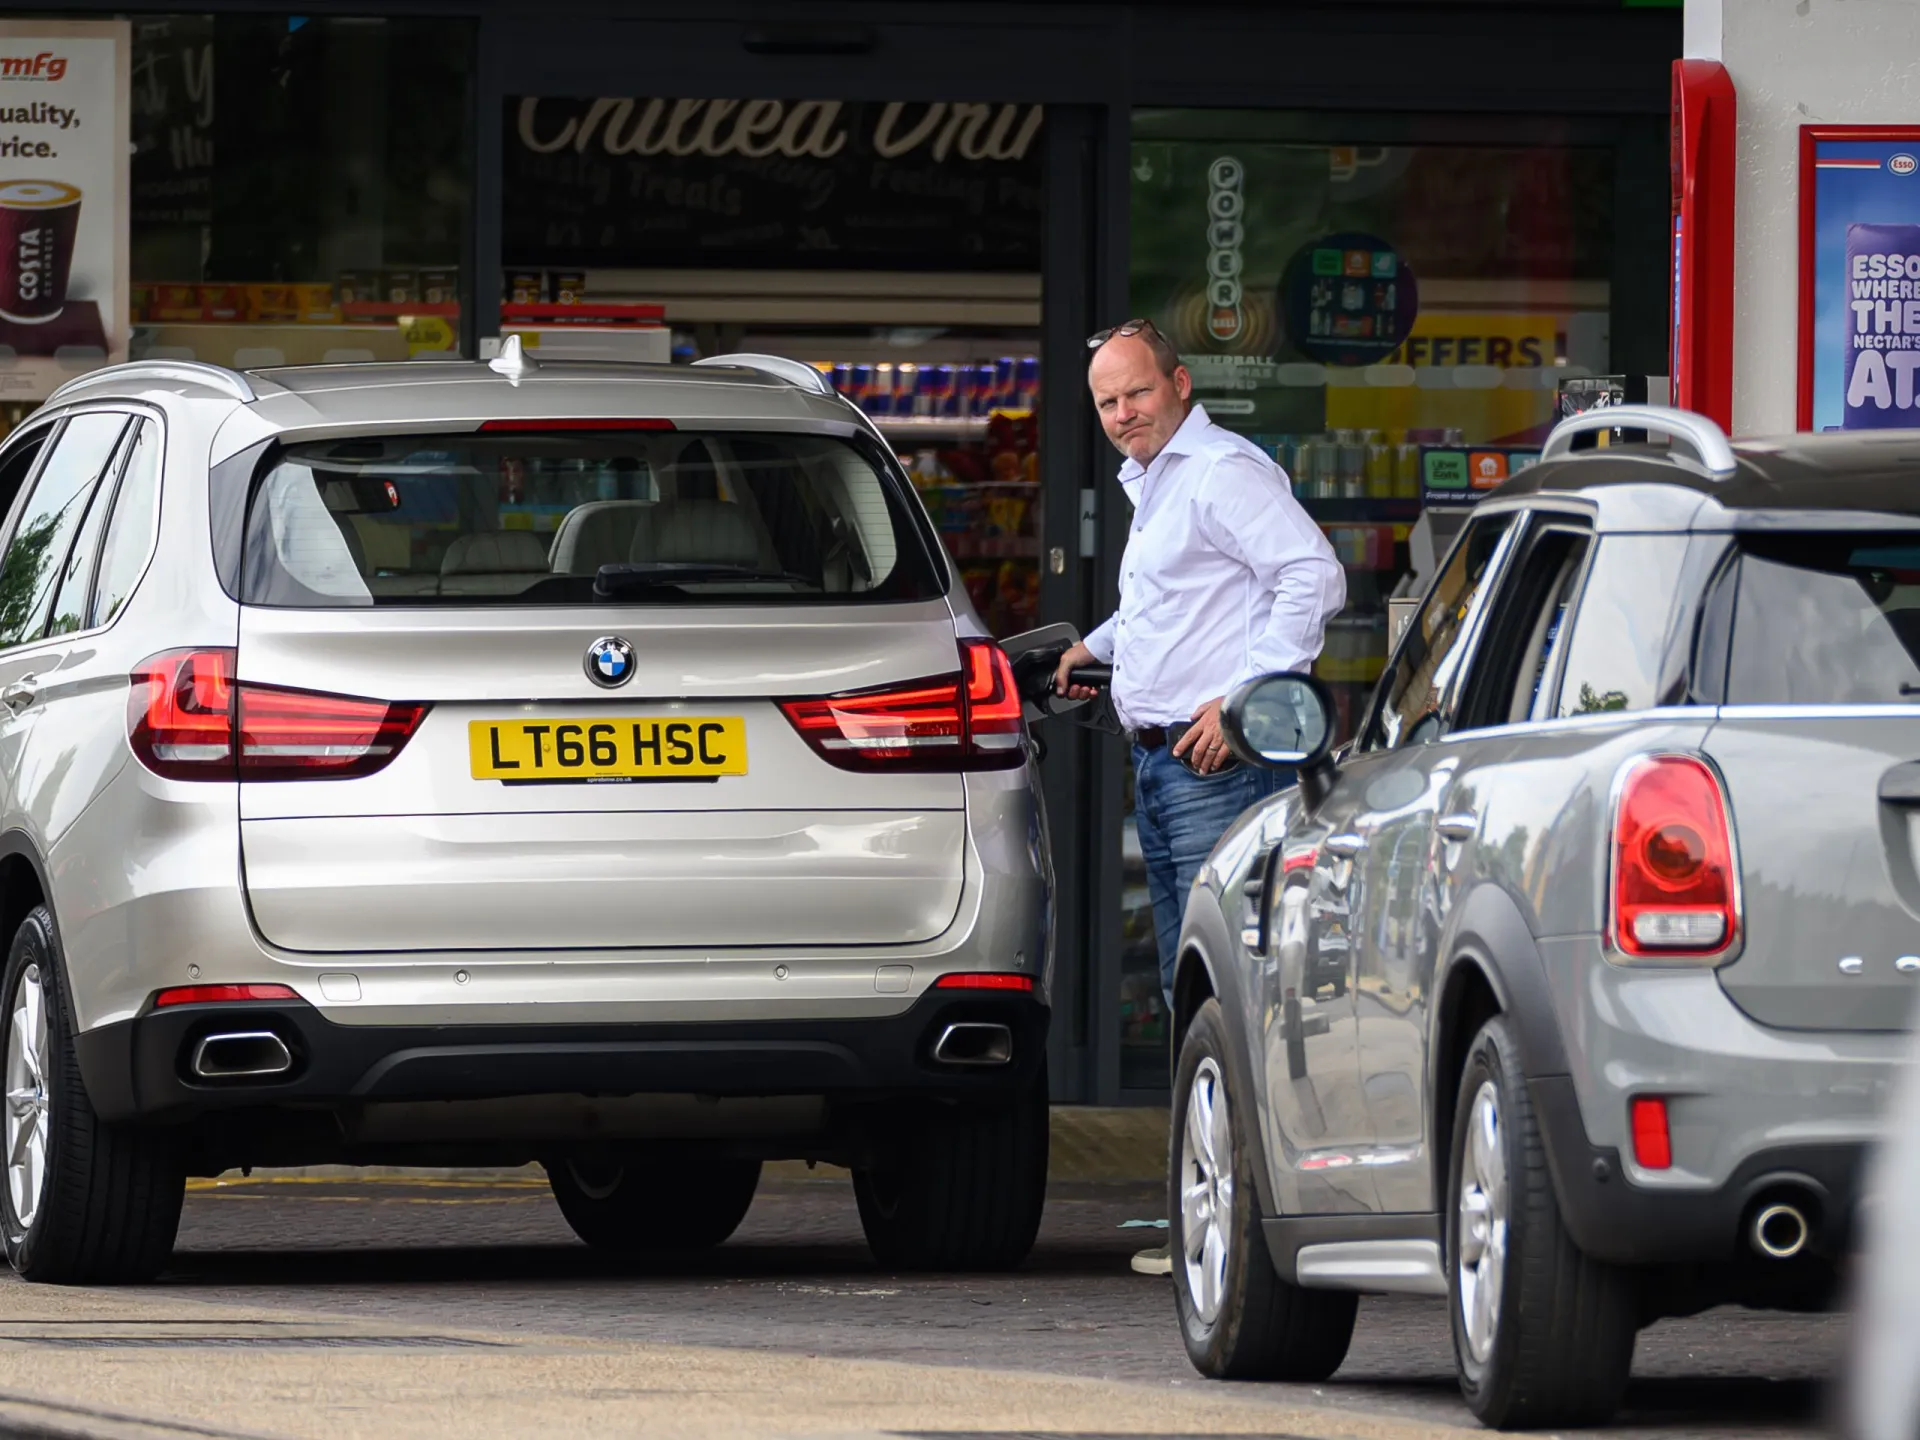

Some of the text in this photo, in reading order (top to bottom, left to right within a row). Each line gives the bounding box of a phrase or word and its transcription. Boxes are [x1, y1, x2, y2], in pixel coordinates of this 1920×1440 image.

[0, 52, 68, 82] mfg
[0, 102, 80, 129] uality,
[0, 135, 58, 158] rice.
[1893, 159, 1913, 170] Esso
[19, 228, 42, 301] COSTA
[1851, 280, 1920, 299] WHERE
[1851, 300, 1920, 334] THE
[490, 722, 727, 769] LT66 HSC
